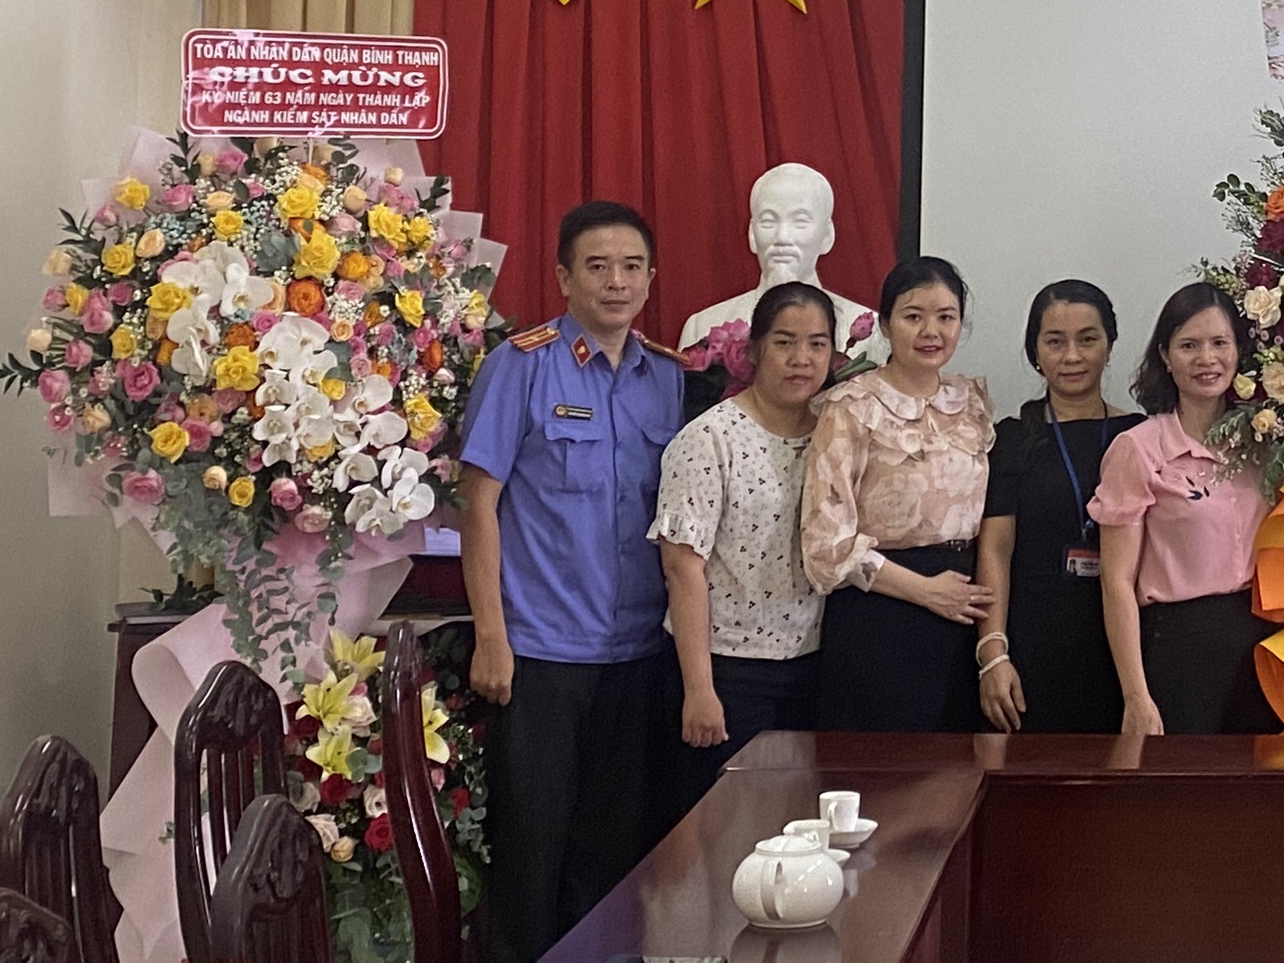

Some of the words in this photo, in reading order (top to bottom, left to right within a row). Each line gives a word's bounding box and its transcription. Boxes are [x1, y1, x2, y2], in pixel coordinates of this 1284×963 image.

[250, 43, 289, 61] NHÂN
[323, 45, 359, 65] QUẬN
[362, 46, 393, 65] BÌNH
[396, 50, 439, 68] THẠNH
[209, 63, 316, 85] CHÚC
[321, 66, 428, 87] MỪNG
[225, 87, 262, 105] NIỆM
[264, 91, 282, 104] 63
[318, 90, 353, 105] NGÀY
[357, 91, 400, 106] THÀNH
[224, 106, 269, 123] NGÀNH
[341, 108, 377, 124] NHÂN
